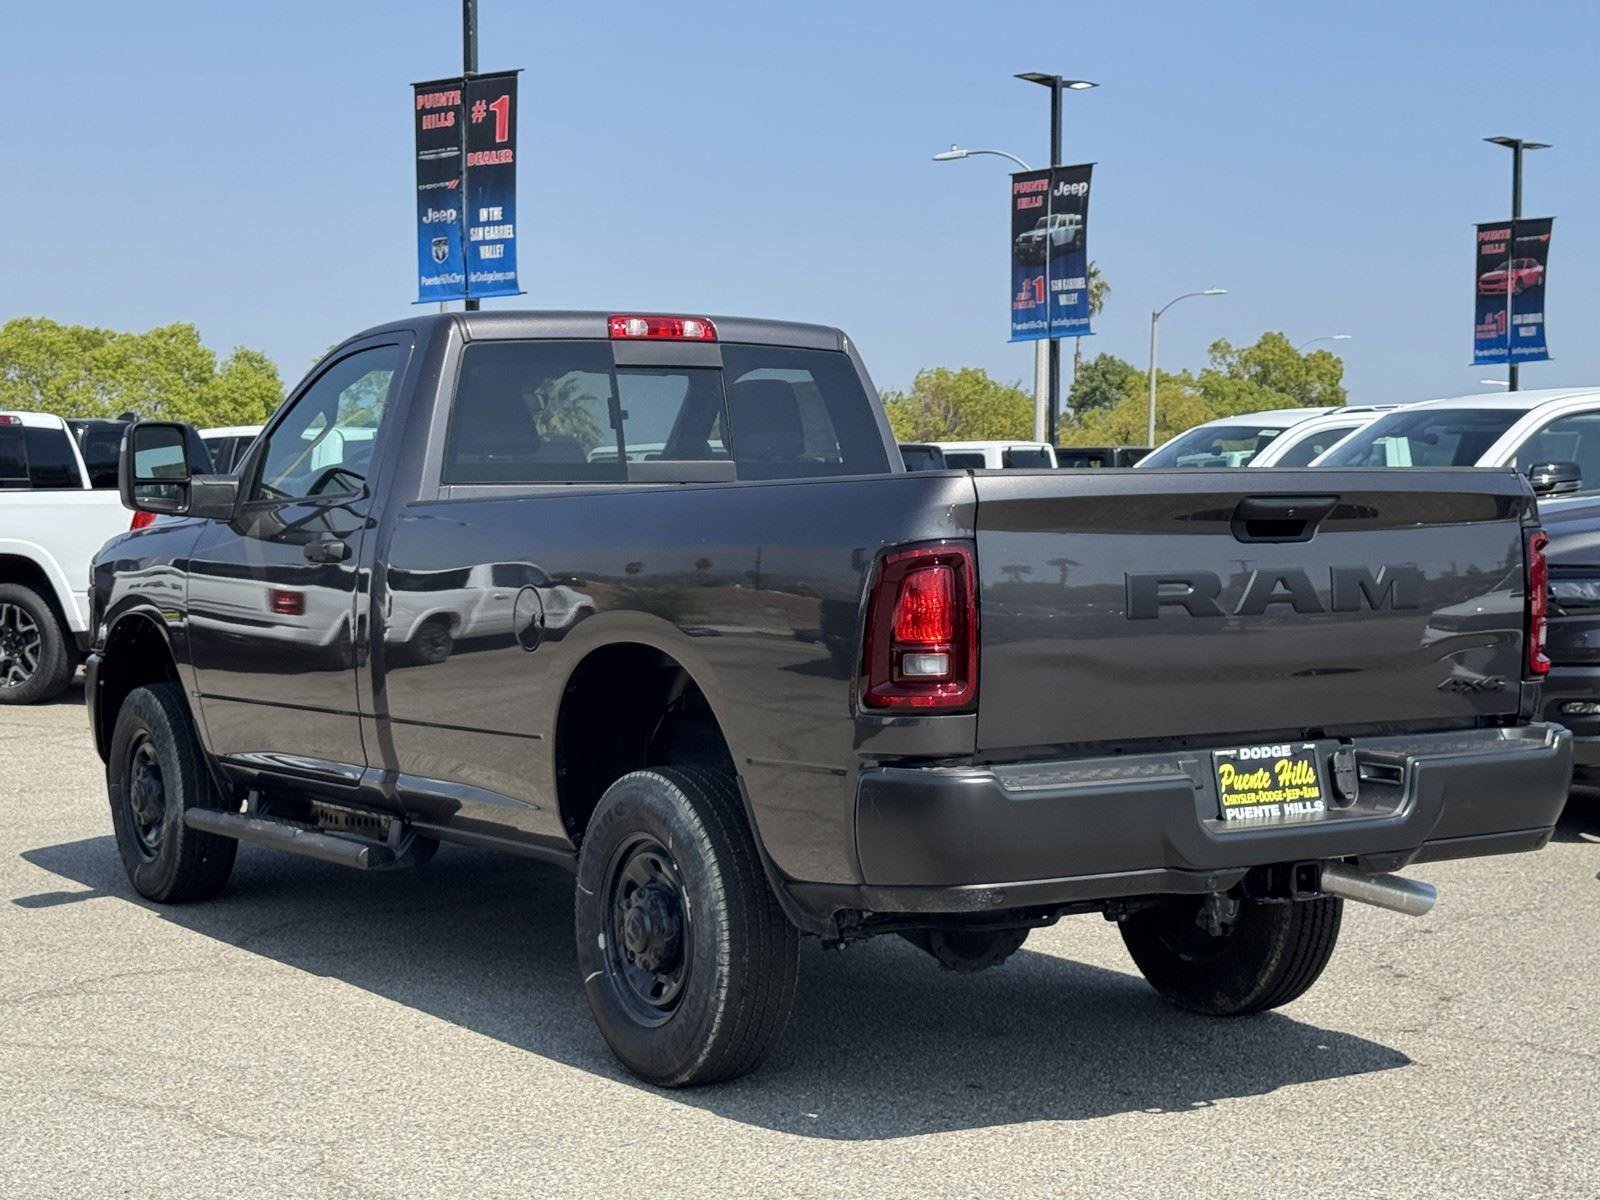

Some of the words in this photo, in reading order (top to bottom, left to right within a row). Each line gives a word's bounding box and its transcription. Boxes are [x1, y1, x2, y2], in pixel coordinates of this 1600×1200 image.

[416, 90, 461, 110] PUENTE
[422, 111, 455, 130] HILLS
[471, 94, 510, 143] #1
[467, 149, 513, 167] DEALER
[1054, 181, 1088, 197] Jeep
[422, 208, 457, 224] Jeep
[489, 207, 503, 221] THE
[1125, 566, 1420, 620] RAM
[1240, 745, 1291, 760] DODGE
[1219, 763, 1271, 792] Puente
[1275, 759, 1316, 787] Hills
[1225, 804, 1281, 820] PUENTE
[1283, 800, 1325, 815] HILLS
